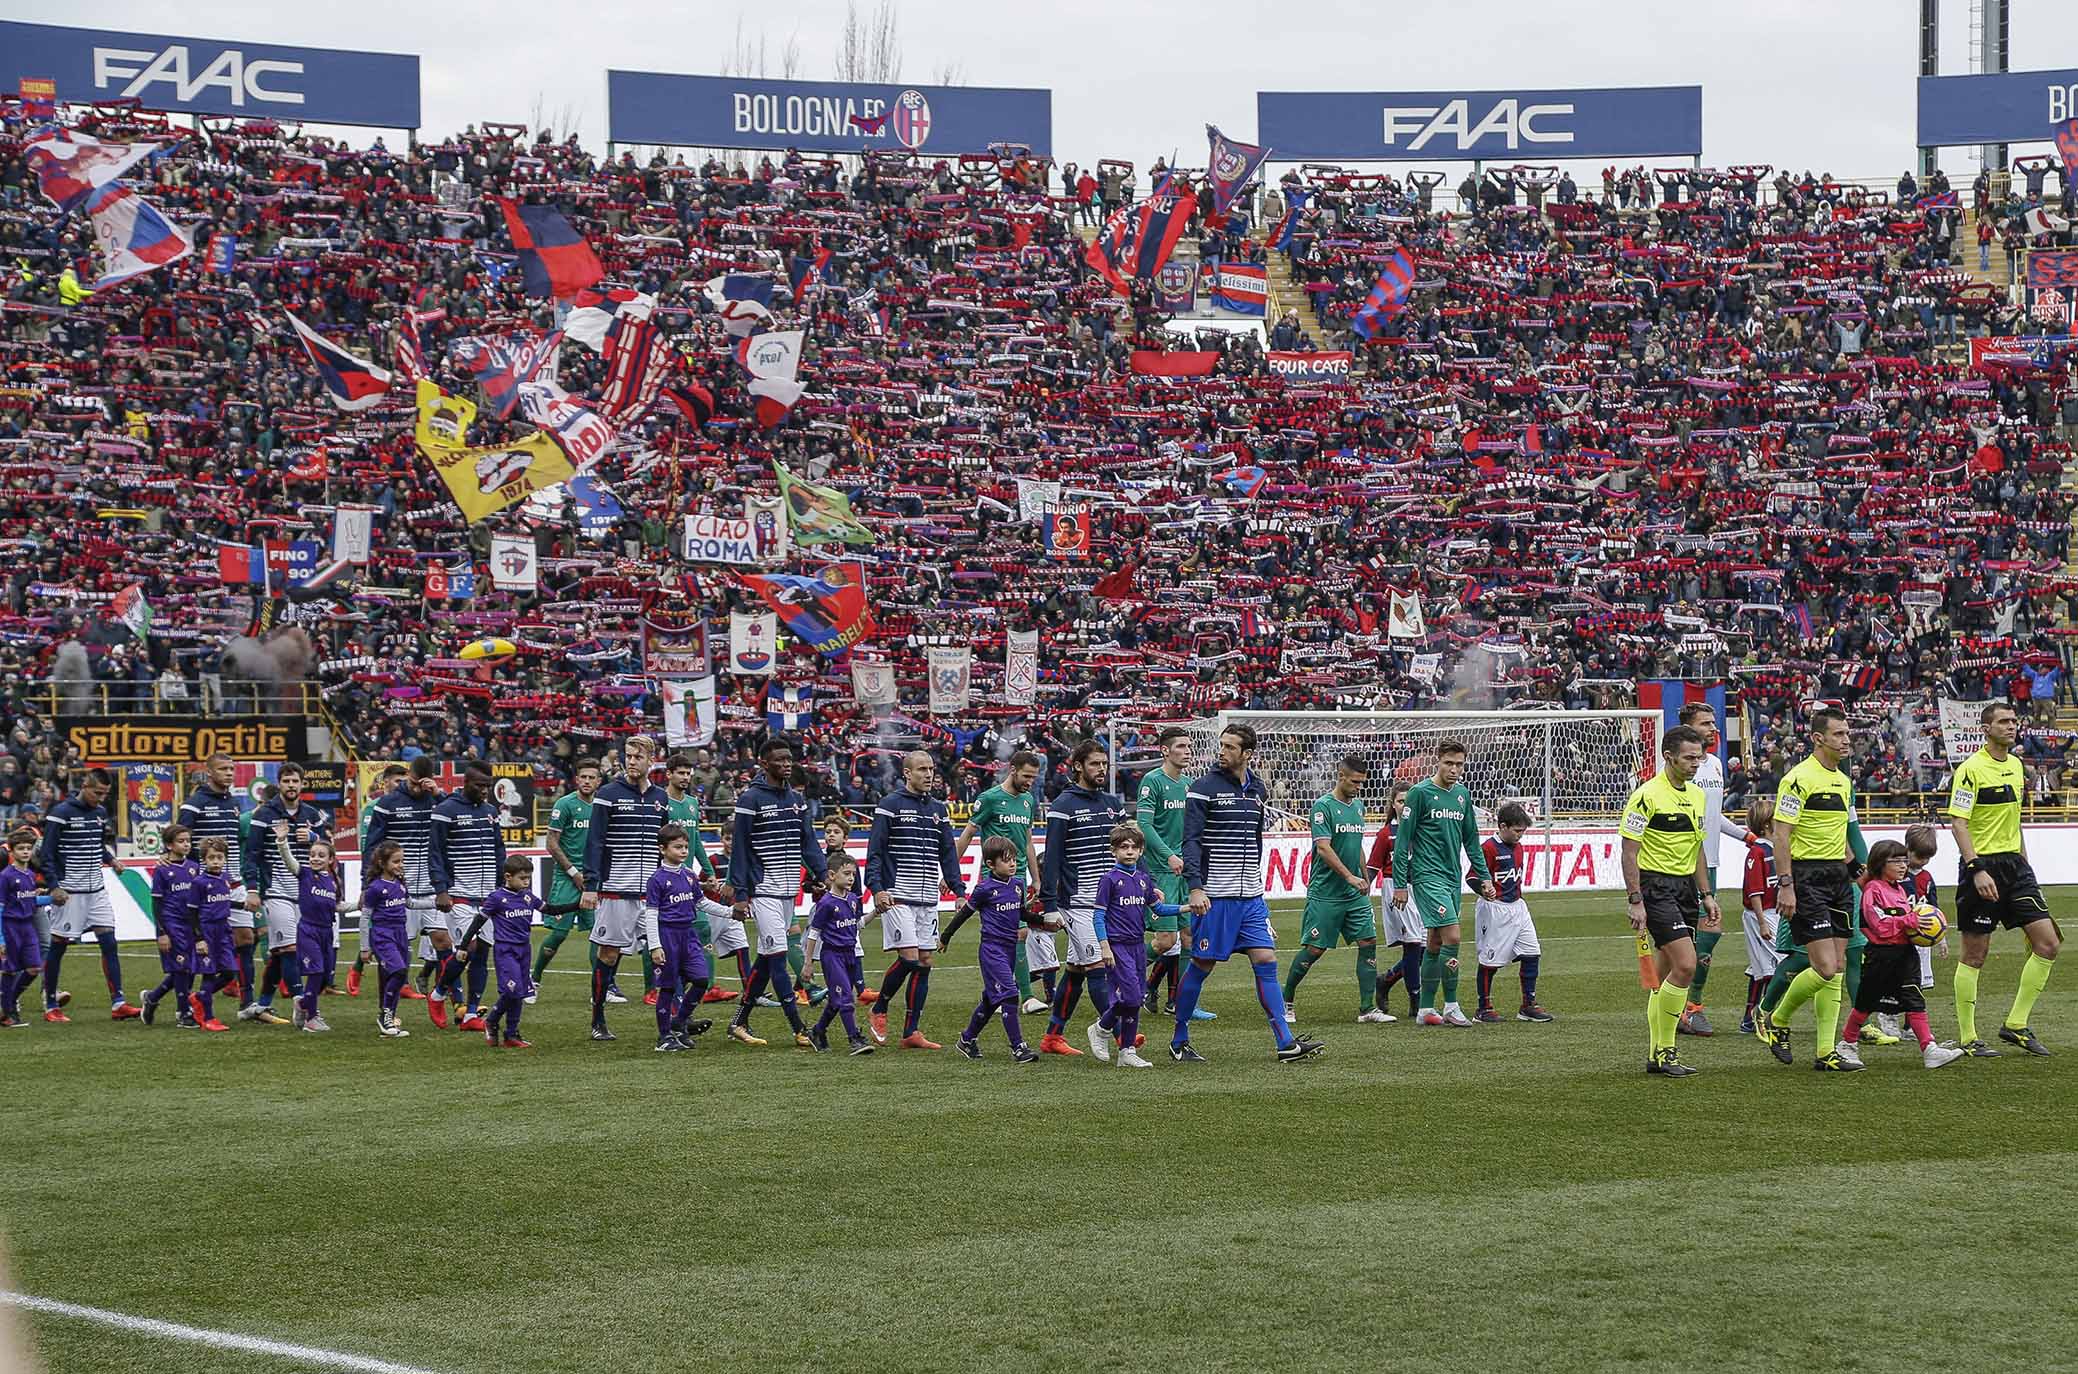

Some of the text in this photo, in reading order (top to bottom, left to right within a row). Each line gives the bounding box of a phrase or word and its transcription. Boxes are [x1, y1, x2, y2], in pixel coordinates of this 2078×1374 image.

[93, 45, 304, 106] FAAC
[733, 93, 860, 137] BOLOGNA
[1383, 99, 1574, 150] FAAC
[1268, 359, 1350, 375] FOUR CATS
[499, 478, 536, 502] 1974
[1045, 503, 1086, 515] BUDRIO
[695, 519, 750, 538] CIAO
[270, 550, 308, 561] FINO
[688, 539, 755, 561] ROMA
[69, 724, 289, 761] Settore Ostile
[1782, 794, 1801, 805] EURO
[1955, 790, 1973, 799] EURO
[131, 803, 169, 818] BOLOGNA
[1780, 801, 1798, 810] VITA
[573, 819, 590, 829] foll
[1626, 818, 1644, 828] VITA
[1629, 813, 1647, 823] EURO
